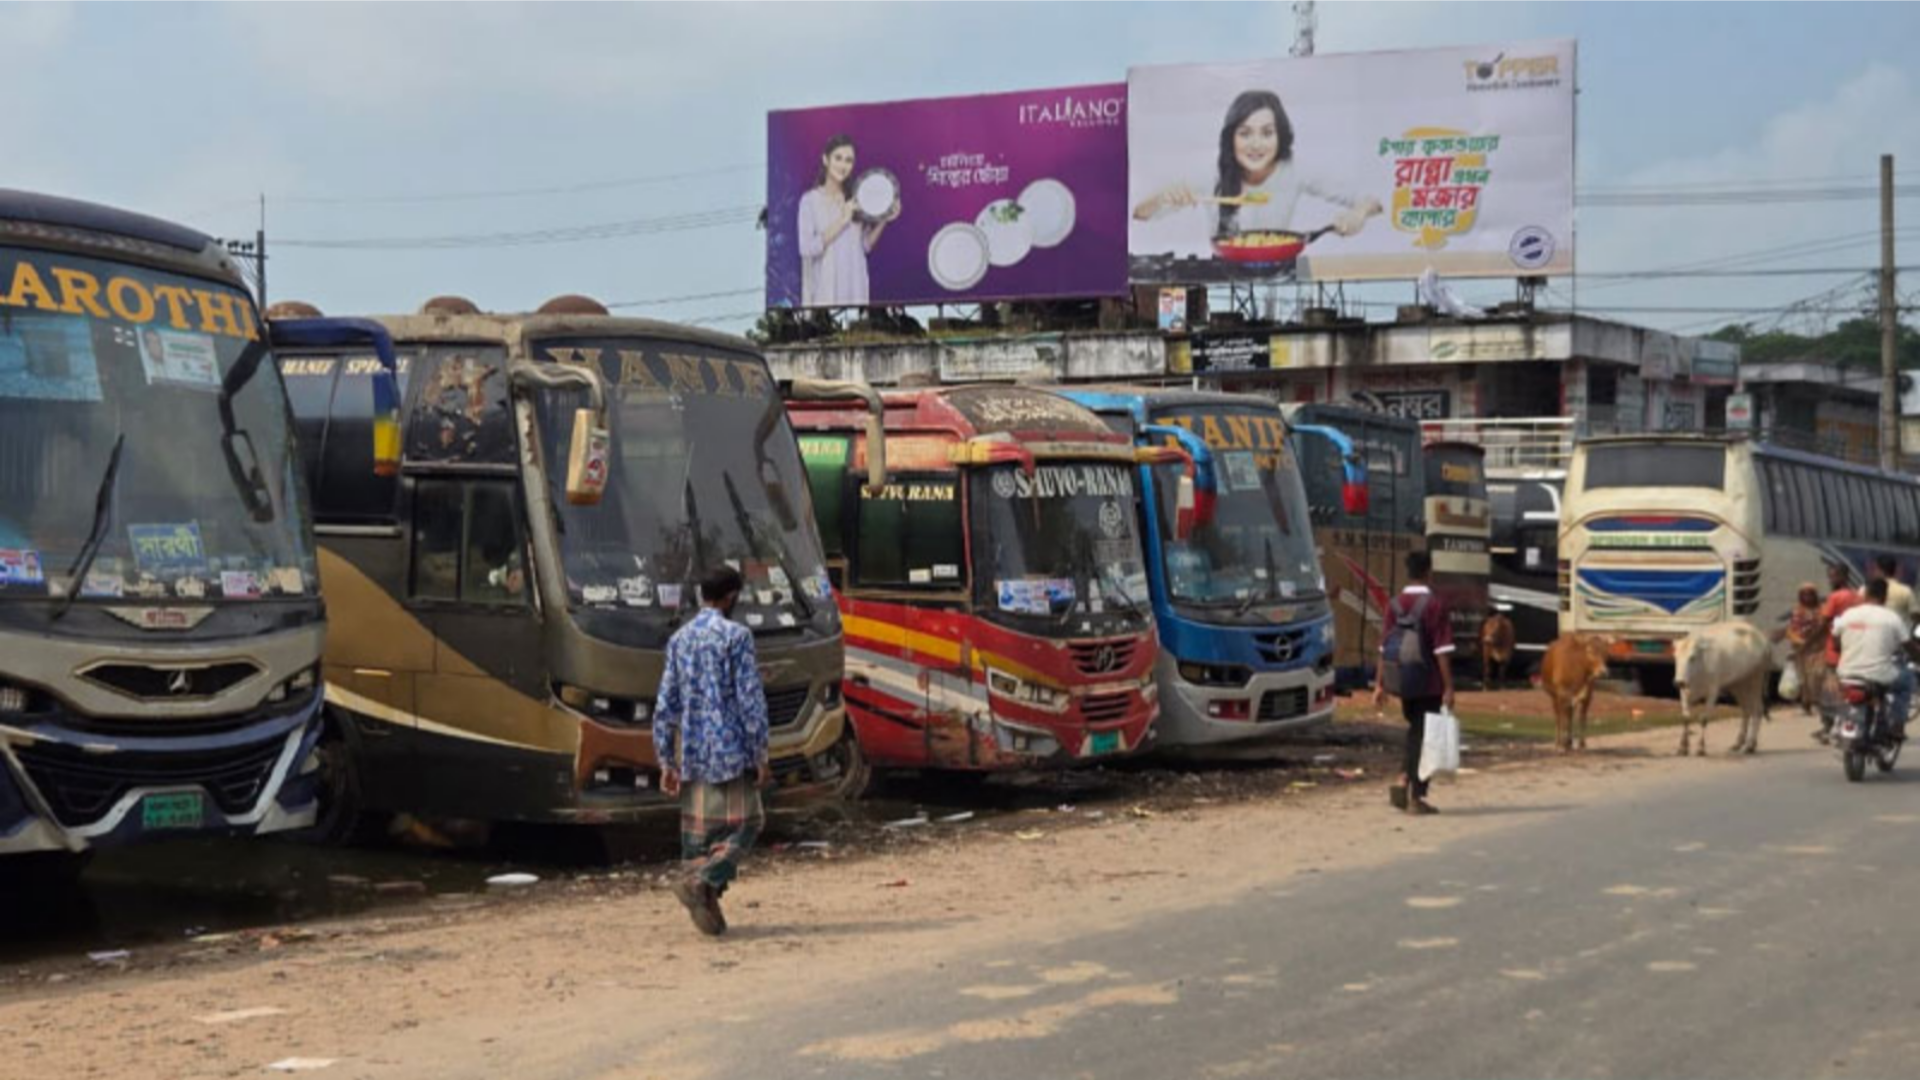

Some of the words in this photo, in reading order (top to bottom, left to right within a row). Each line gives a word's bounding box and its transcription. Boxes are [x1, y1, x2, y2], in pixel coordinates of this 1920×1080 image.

[1019, 96, 1120, 124] ITALIANO
[1394, 156, 1455, 188] রান্না
[1411, 185, 1481, 210] মজার
[0, 262, 260, 342] AROTHI
